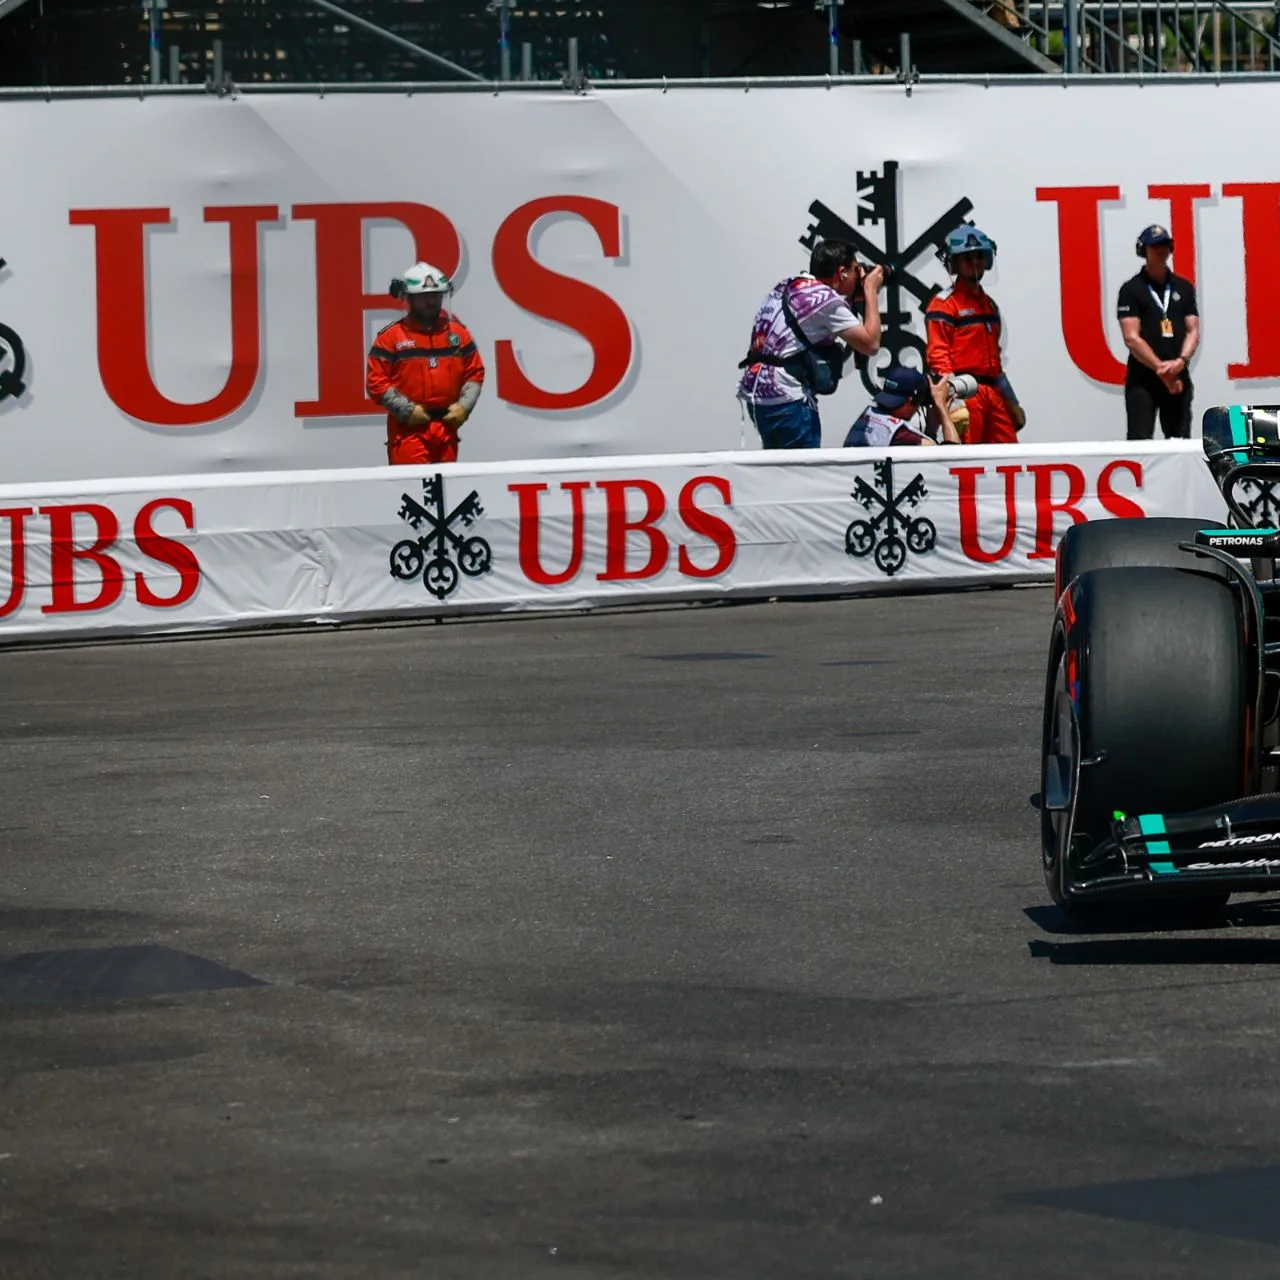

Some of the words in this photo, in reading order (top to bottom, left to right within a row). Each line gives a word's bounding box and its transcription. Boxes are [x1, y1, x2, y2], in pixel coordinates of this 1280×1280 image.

[69, 194, 632, 425] UBS
[508, 476, 736, 586] UBS
[949, 459, 1146, 564] UBS
[1209, 536, 1263, 546] PETRONAS
